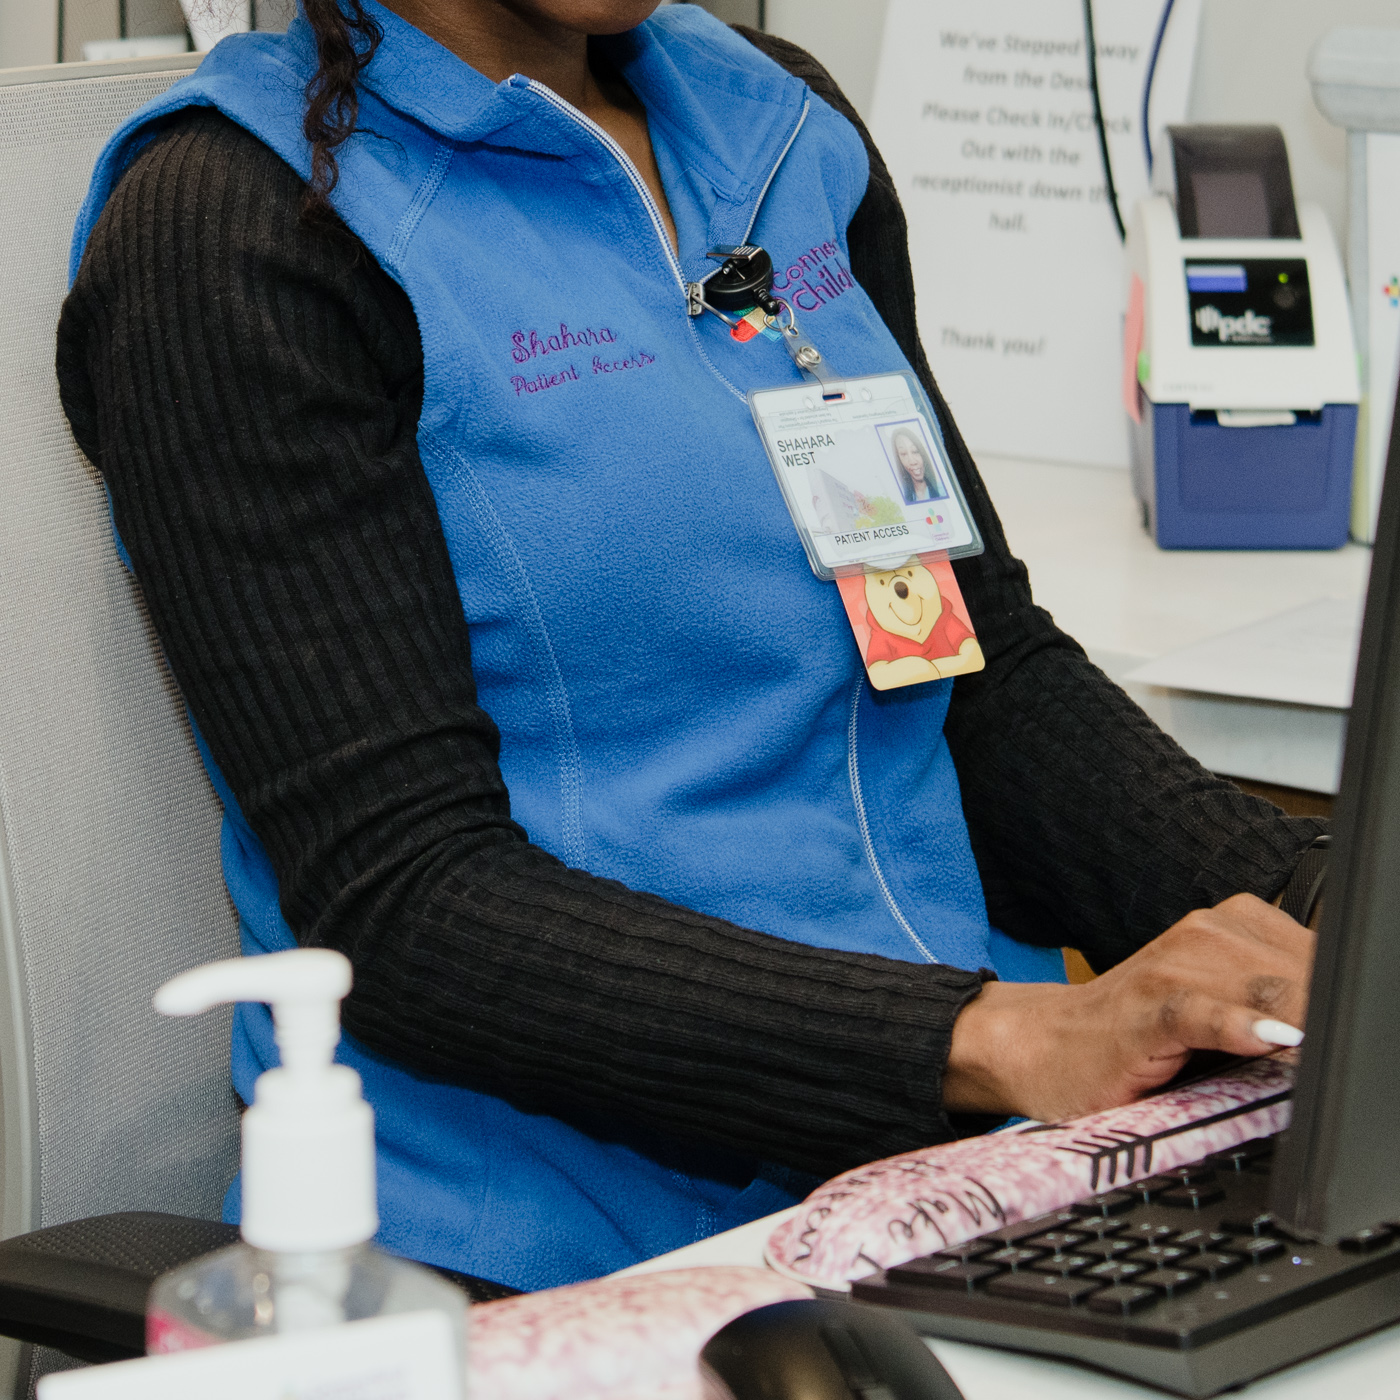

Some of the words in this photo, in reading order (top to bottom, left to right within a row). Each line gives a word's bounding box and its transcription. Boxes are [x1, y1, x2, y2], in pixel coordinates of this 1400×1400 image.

[939, 32, 997, 50] We've
[1003, 35, 1080, 57] Stepped
[1090, 43, 1140, 64] way
[963, 65, 1007, 85] from
[1013, 69, 1045, 88] the
[1050, 71, 1095, 91] Des
[921, 102, 980, 123] Please
[986, 104, 1041, 128] Check
[961, 139, 995, 157] Out
[1001, 142, 1043, 162] with
[1049, 146, 1081, 166] the
[912, 173, 1024, 198] receptionist
[1029, 178, 1082, 202] down
[988, 211, 1028, 232] hall.
[1218, 309, 1272, 342] pdc
[510, 322, 618, 364] Shahara
[940, 327, 996, 355] Thank
[1003, 332, 1046, 357] you!
[510, 365, 580, 397] Patient
[591, 352, 656, 375] Access
[777, 434, 836, 453] SHAHARA
[782, 451, 817, 468] WEST
[834, 531, 872, 546] PATIENT
[873, 525, 910, 540] ACCESS
